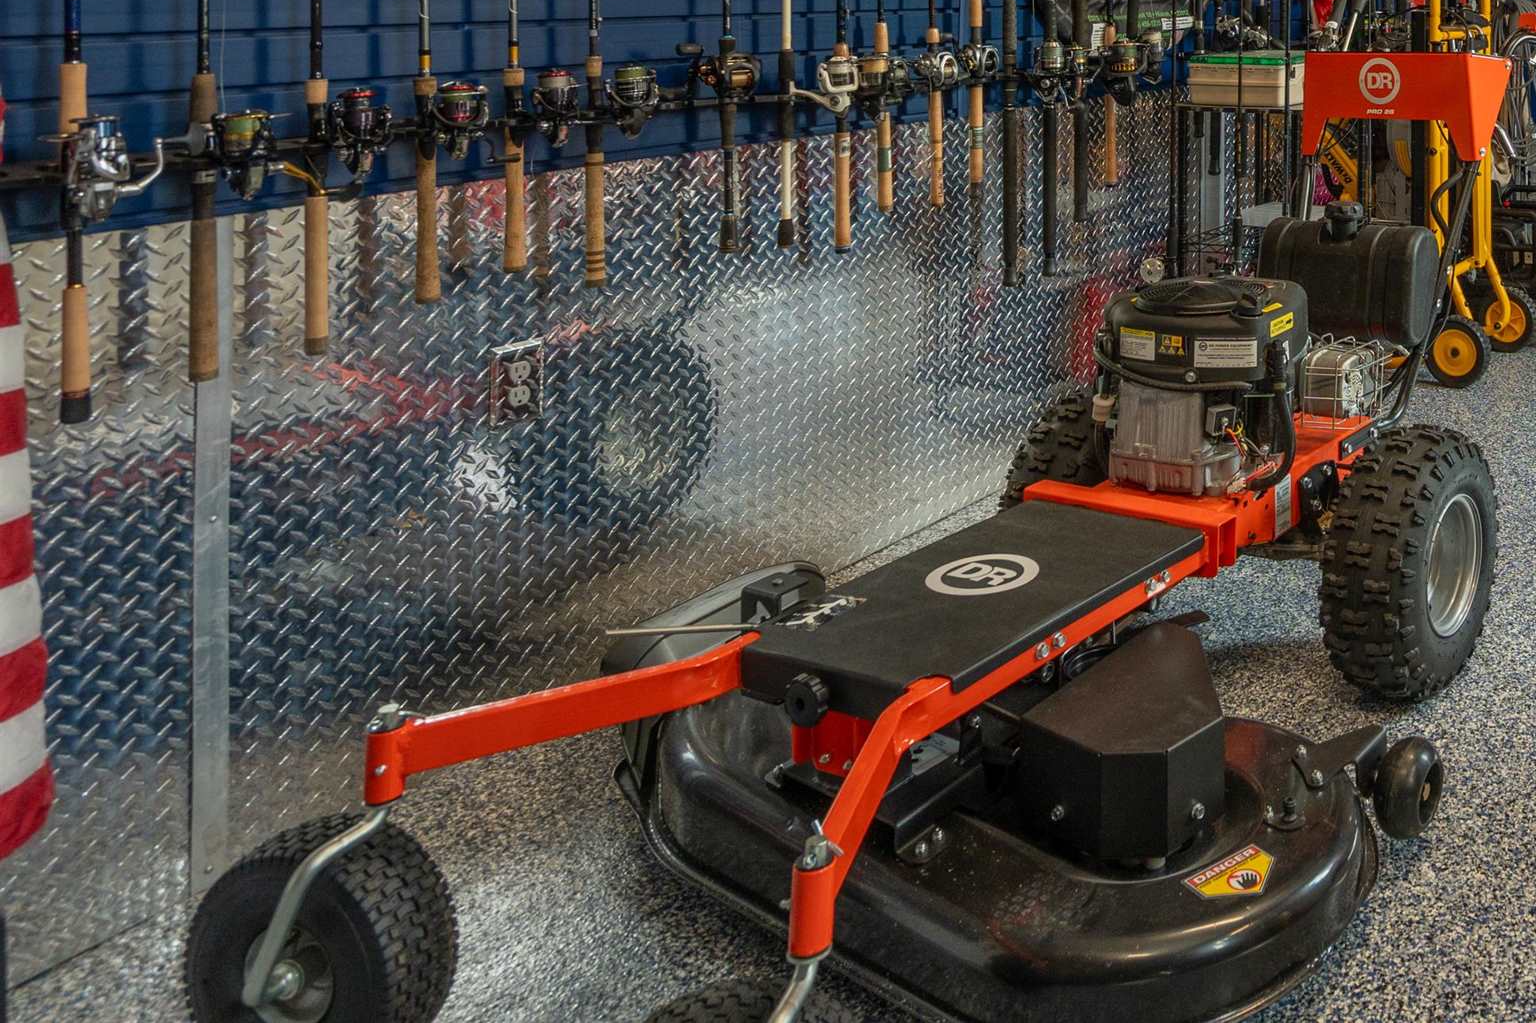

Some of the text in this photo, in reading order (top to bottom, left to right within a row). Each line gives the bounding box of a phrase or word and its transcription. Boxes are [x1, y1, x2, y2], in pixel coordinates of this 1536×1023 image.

[1366, 72, 1393, 89] DR
[946, 562, 1018, 586] DR
[1193, 848, 1252, 884] DANGER
